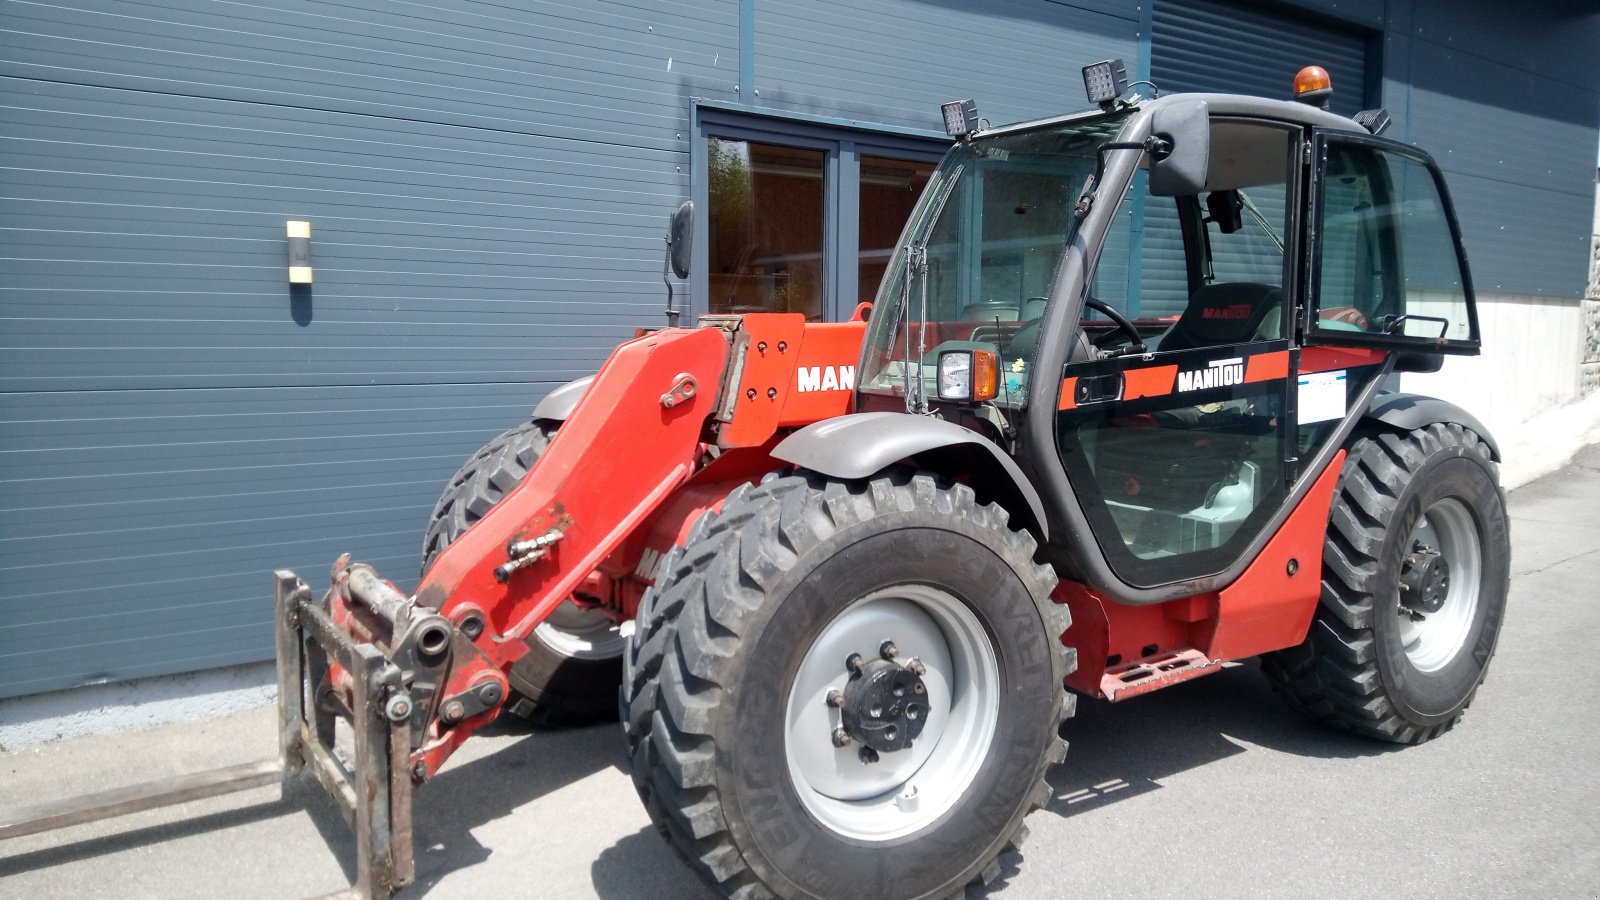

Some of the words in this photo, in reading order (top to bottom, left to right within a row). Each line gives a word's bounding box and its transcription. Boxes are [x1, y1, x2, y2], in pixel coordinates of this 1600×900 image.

[1202, 304, 1252, 319] MANITOU
[797, 365, 855, 393] MAN
[1178, 357, 1244, 392] MANITOU
